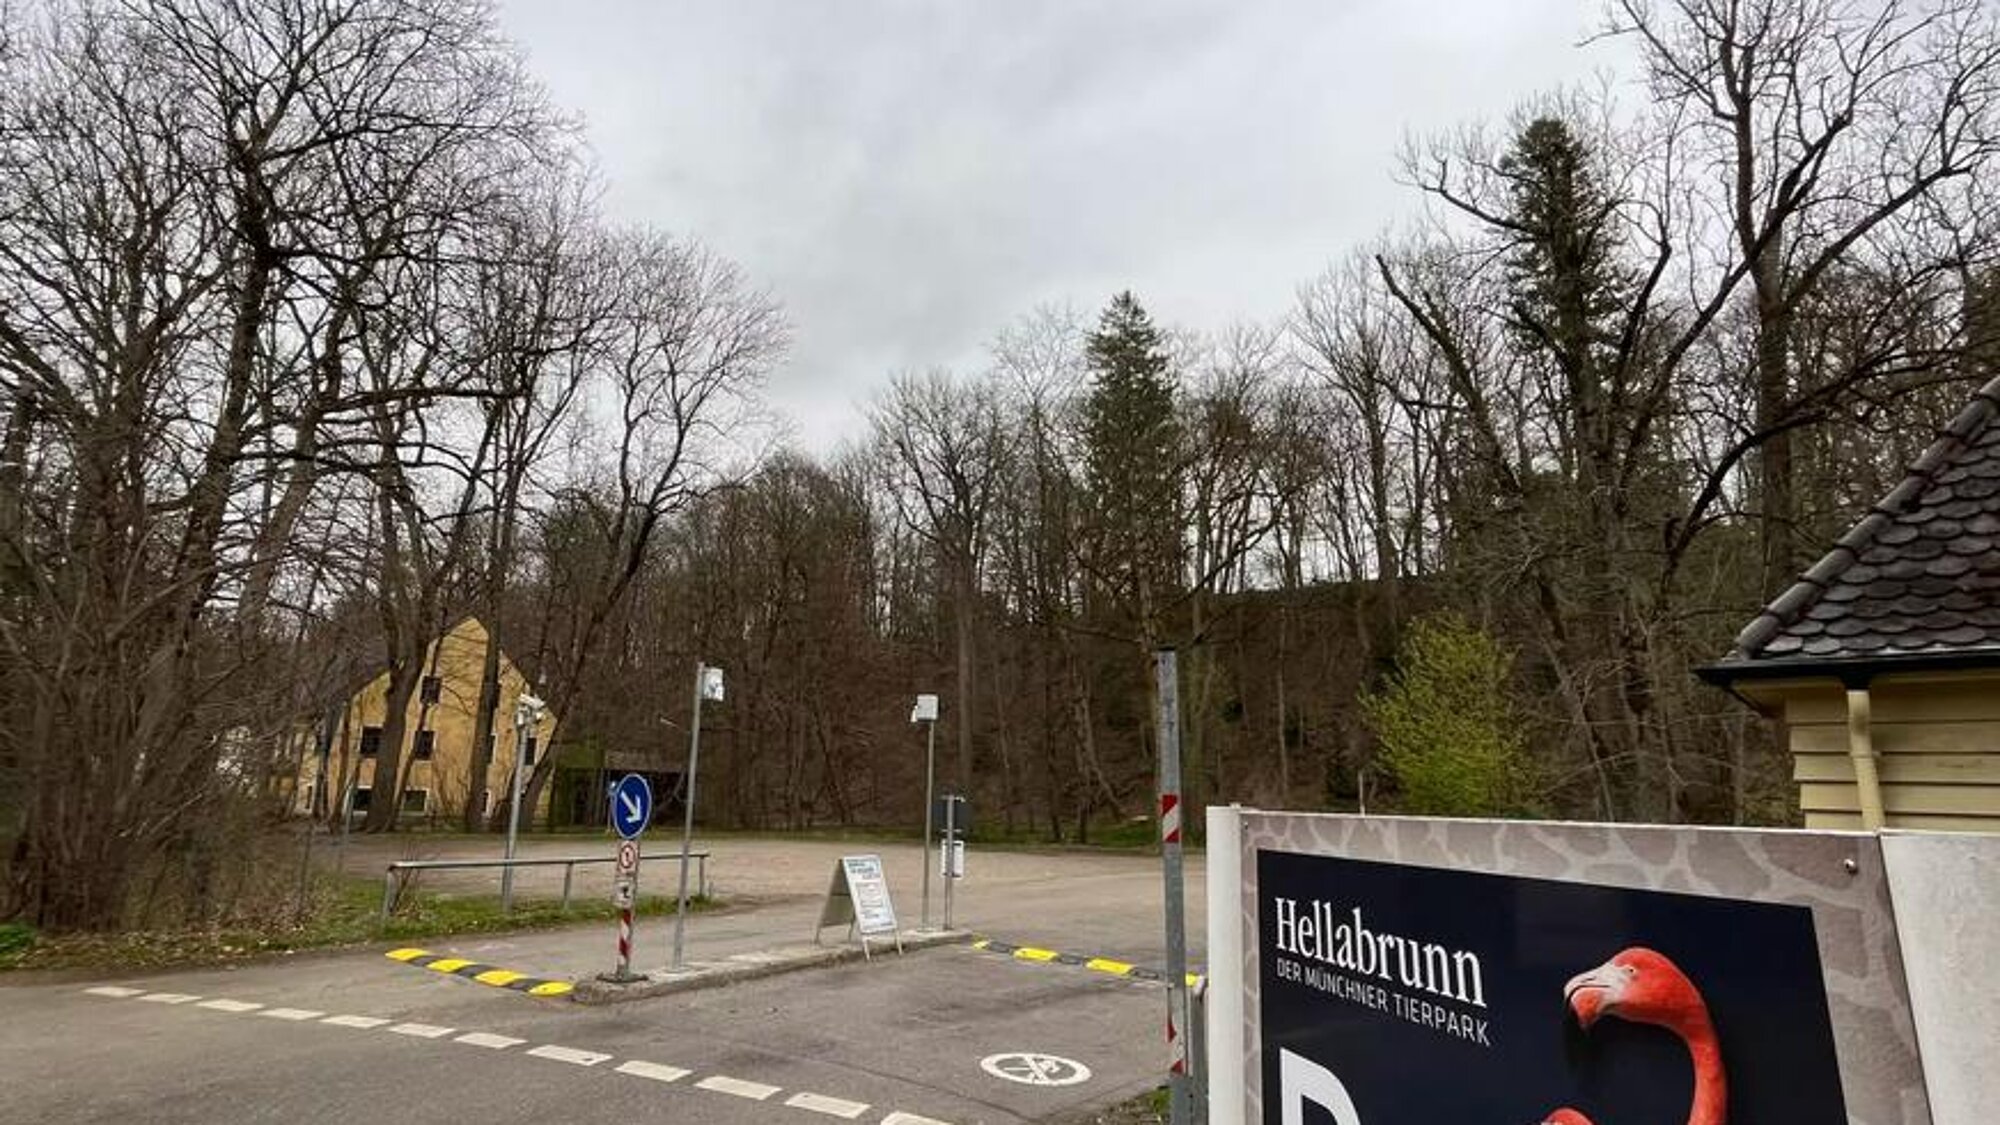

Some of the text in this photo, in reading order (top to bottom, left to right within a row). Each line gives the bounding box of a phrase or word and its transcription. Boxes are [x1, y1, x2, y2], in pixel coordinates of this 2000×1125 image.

[1275, 897, 1487, 1008] Hellabrunn
[1277, 957, 1491, 1046] DER MÜNCHNER TIERPARK
